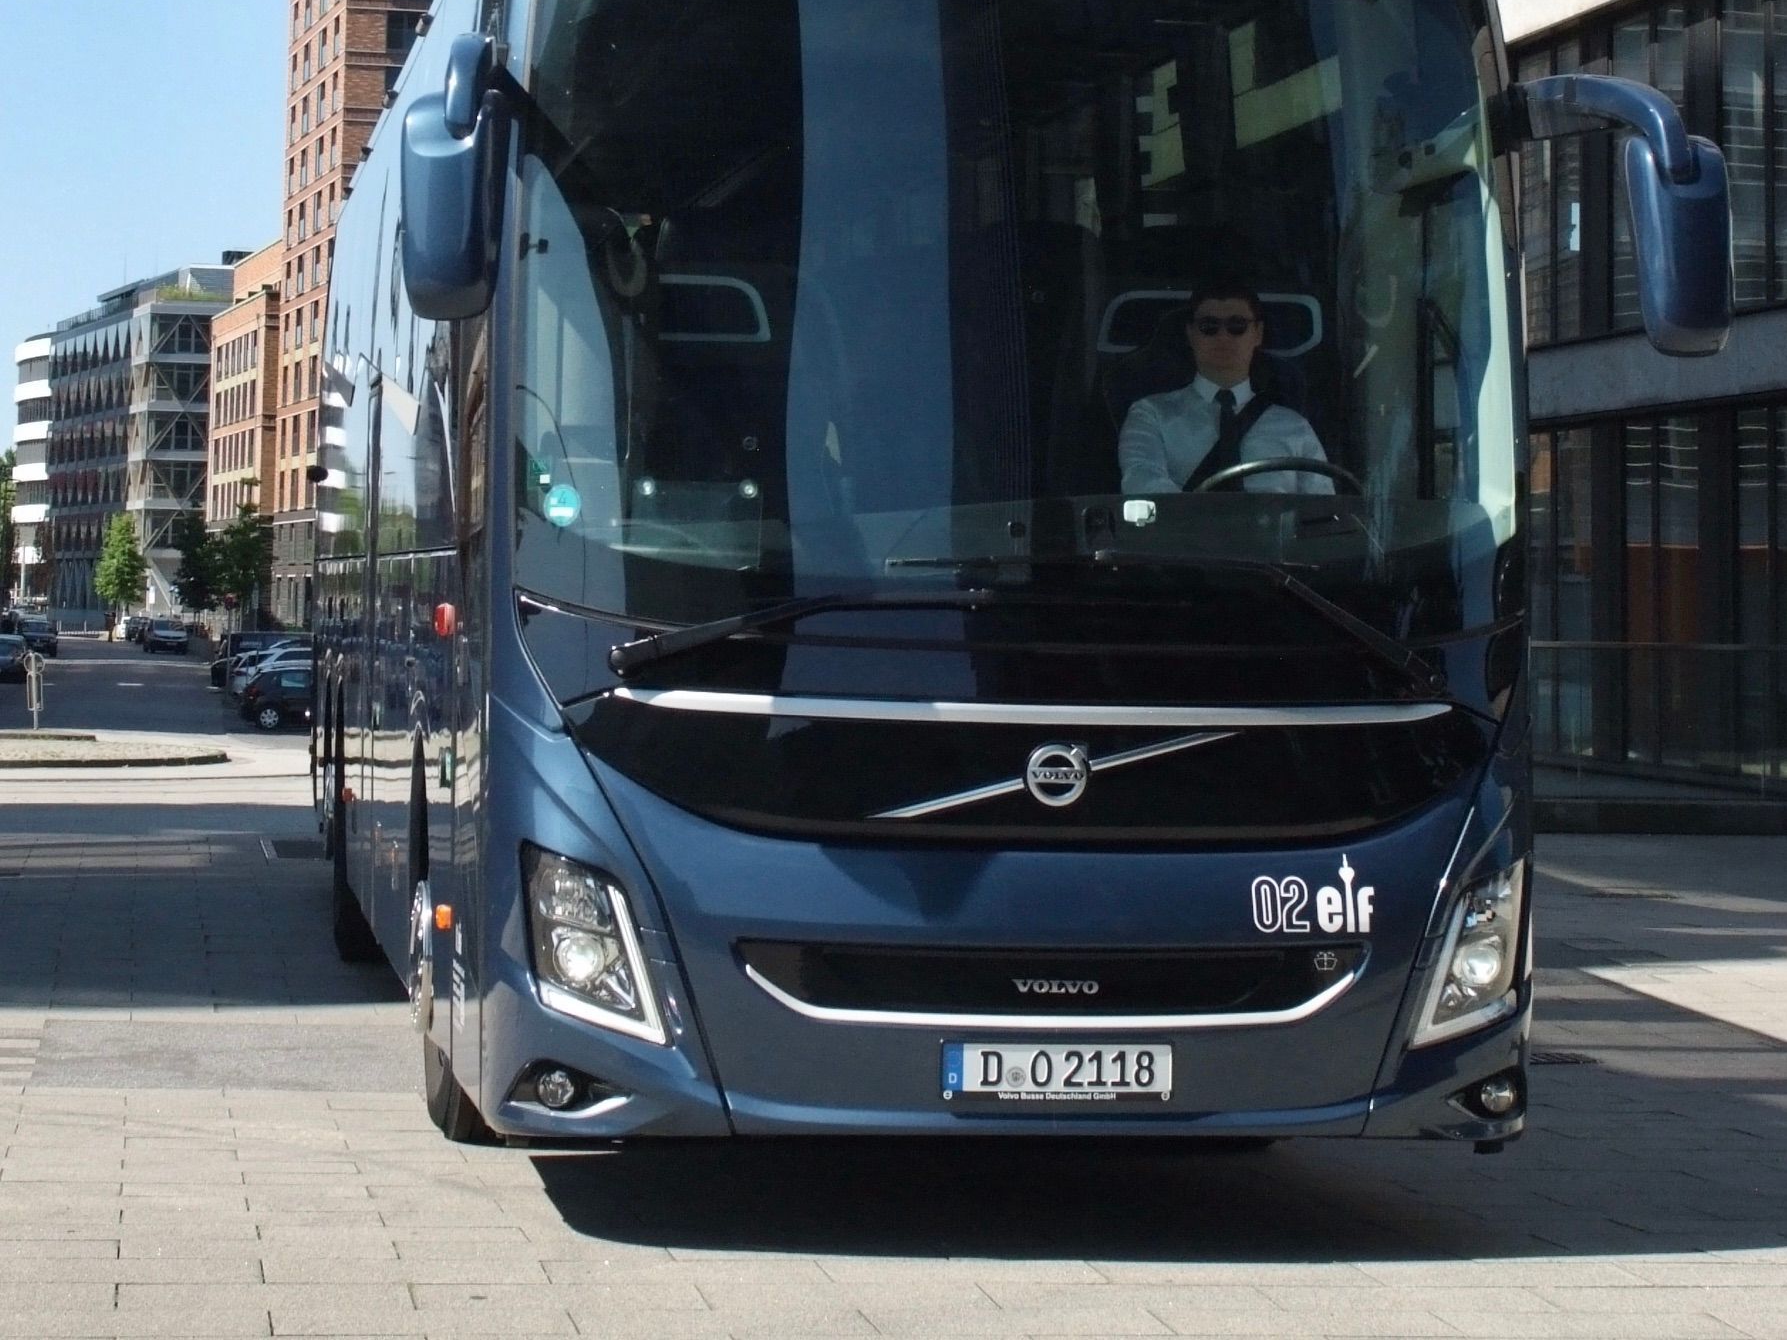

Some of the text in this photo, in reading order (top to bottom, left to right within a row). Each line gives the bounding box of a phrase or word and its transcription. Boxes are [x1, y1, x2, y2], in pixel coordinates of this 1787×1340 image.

[1031, 770, 1084, 780] VOLVO
[1252, 853, 1375, 933] 02 elf
[1011, 978, 1099, 994] VOLVO
[979, 1050, 1003, 1087] D
[1062, 1050, 1155, 1088] 2118
[948, 1072, 958, 1084] D
[997, 1091, 1117, 1100] Volvo Busse Deutschland GmbH
